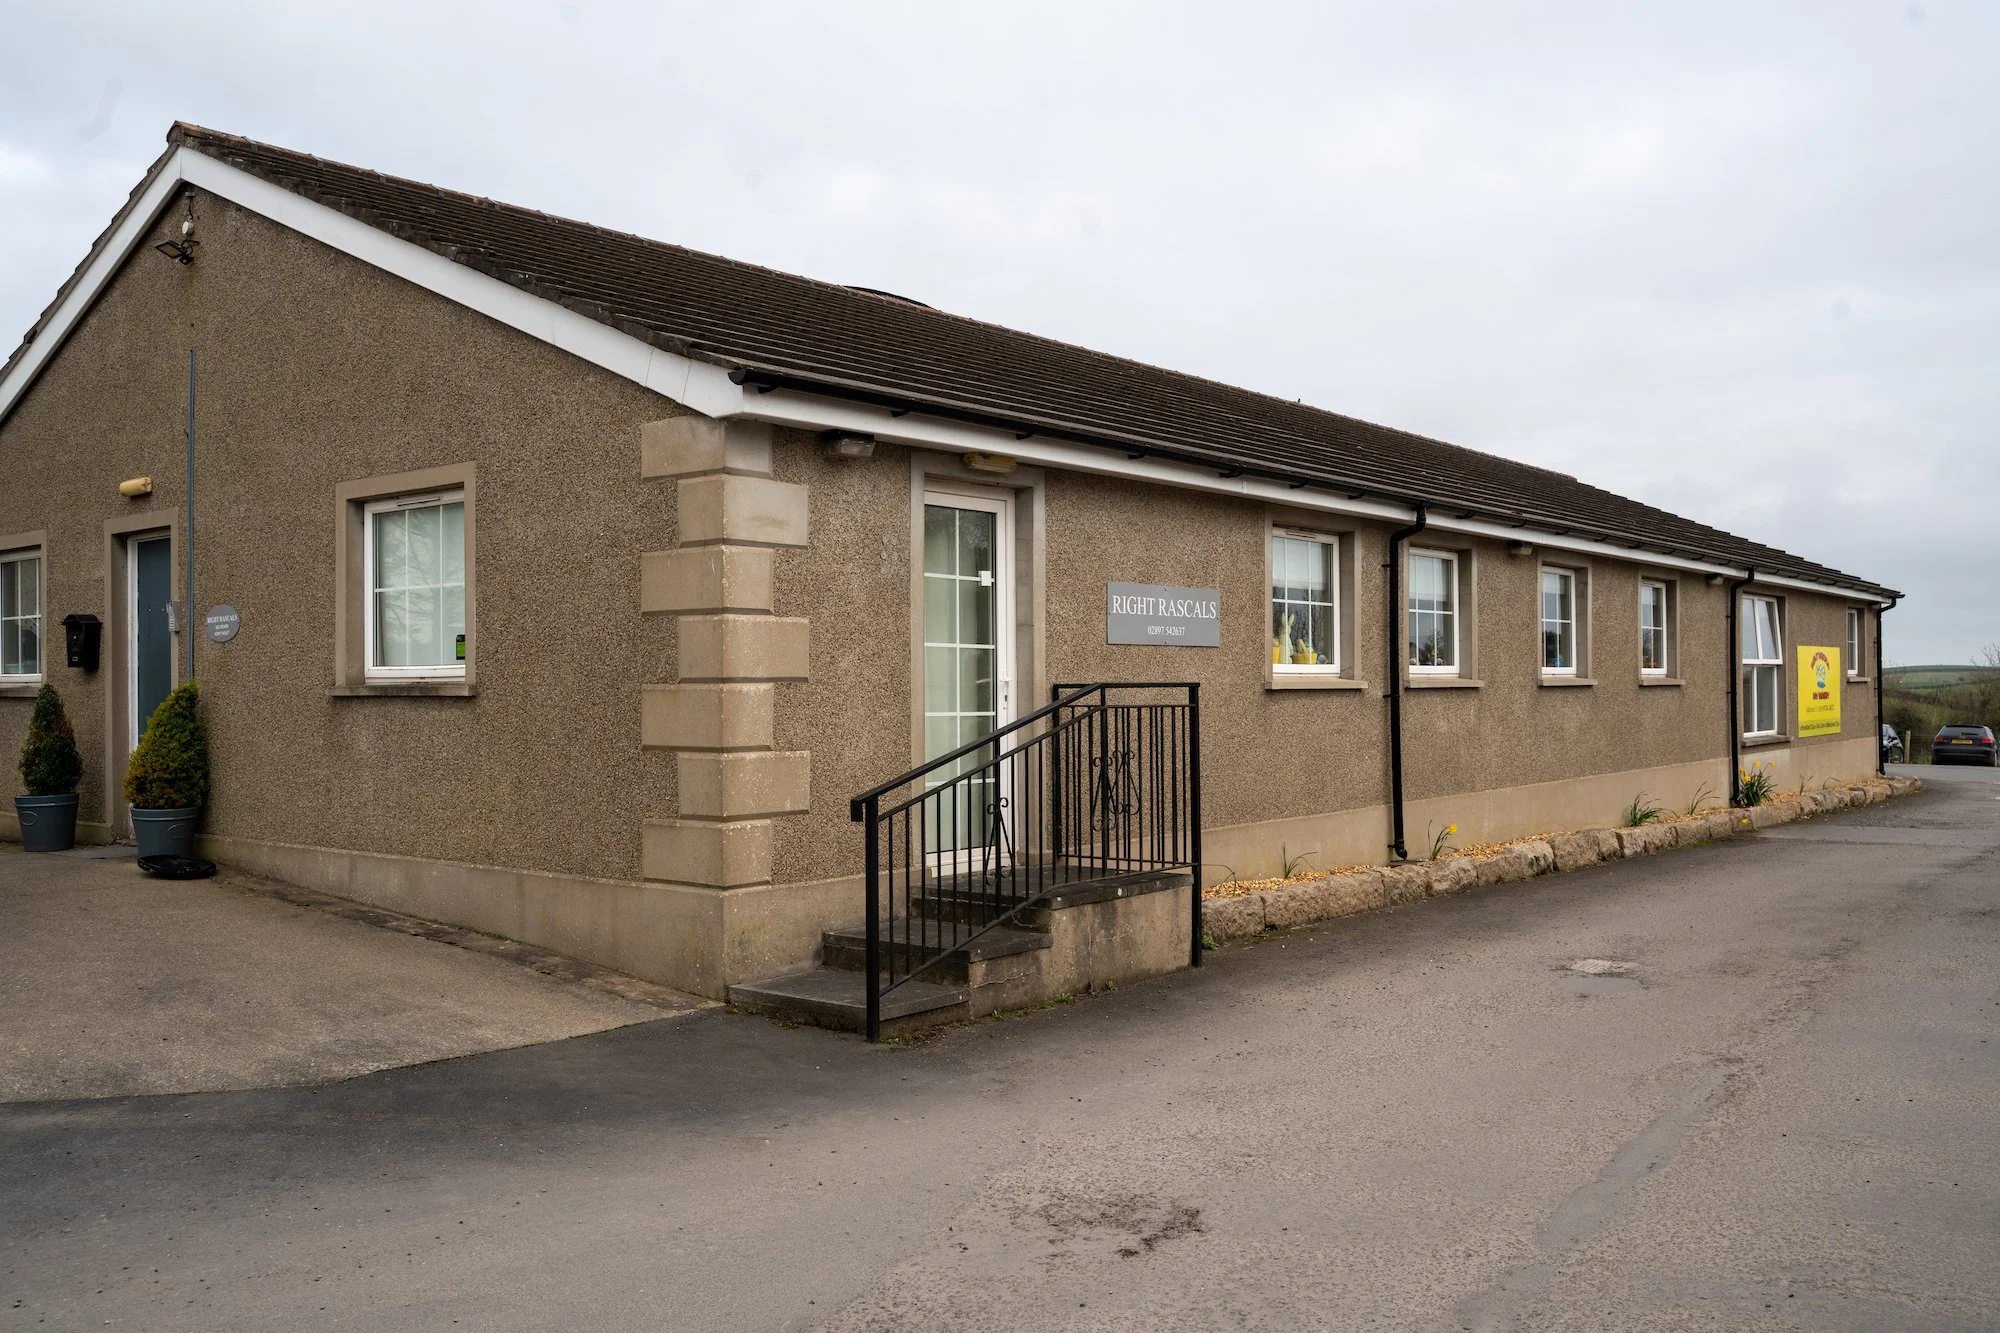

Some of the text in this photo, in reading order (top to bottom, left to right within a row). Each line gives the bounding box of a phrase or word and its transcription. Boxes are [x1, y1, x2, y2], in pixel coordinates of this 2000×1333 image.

[1112, 595, 1217, 619] RIGHT RASCALS
[1147, 625, 1185, 636] 02897 542637
